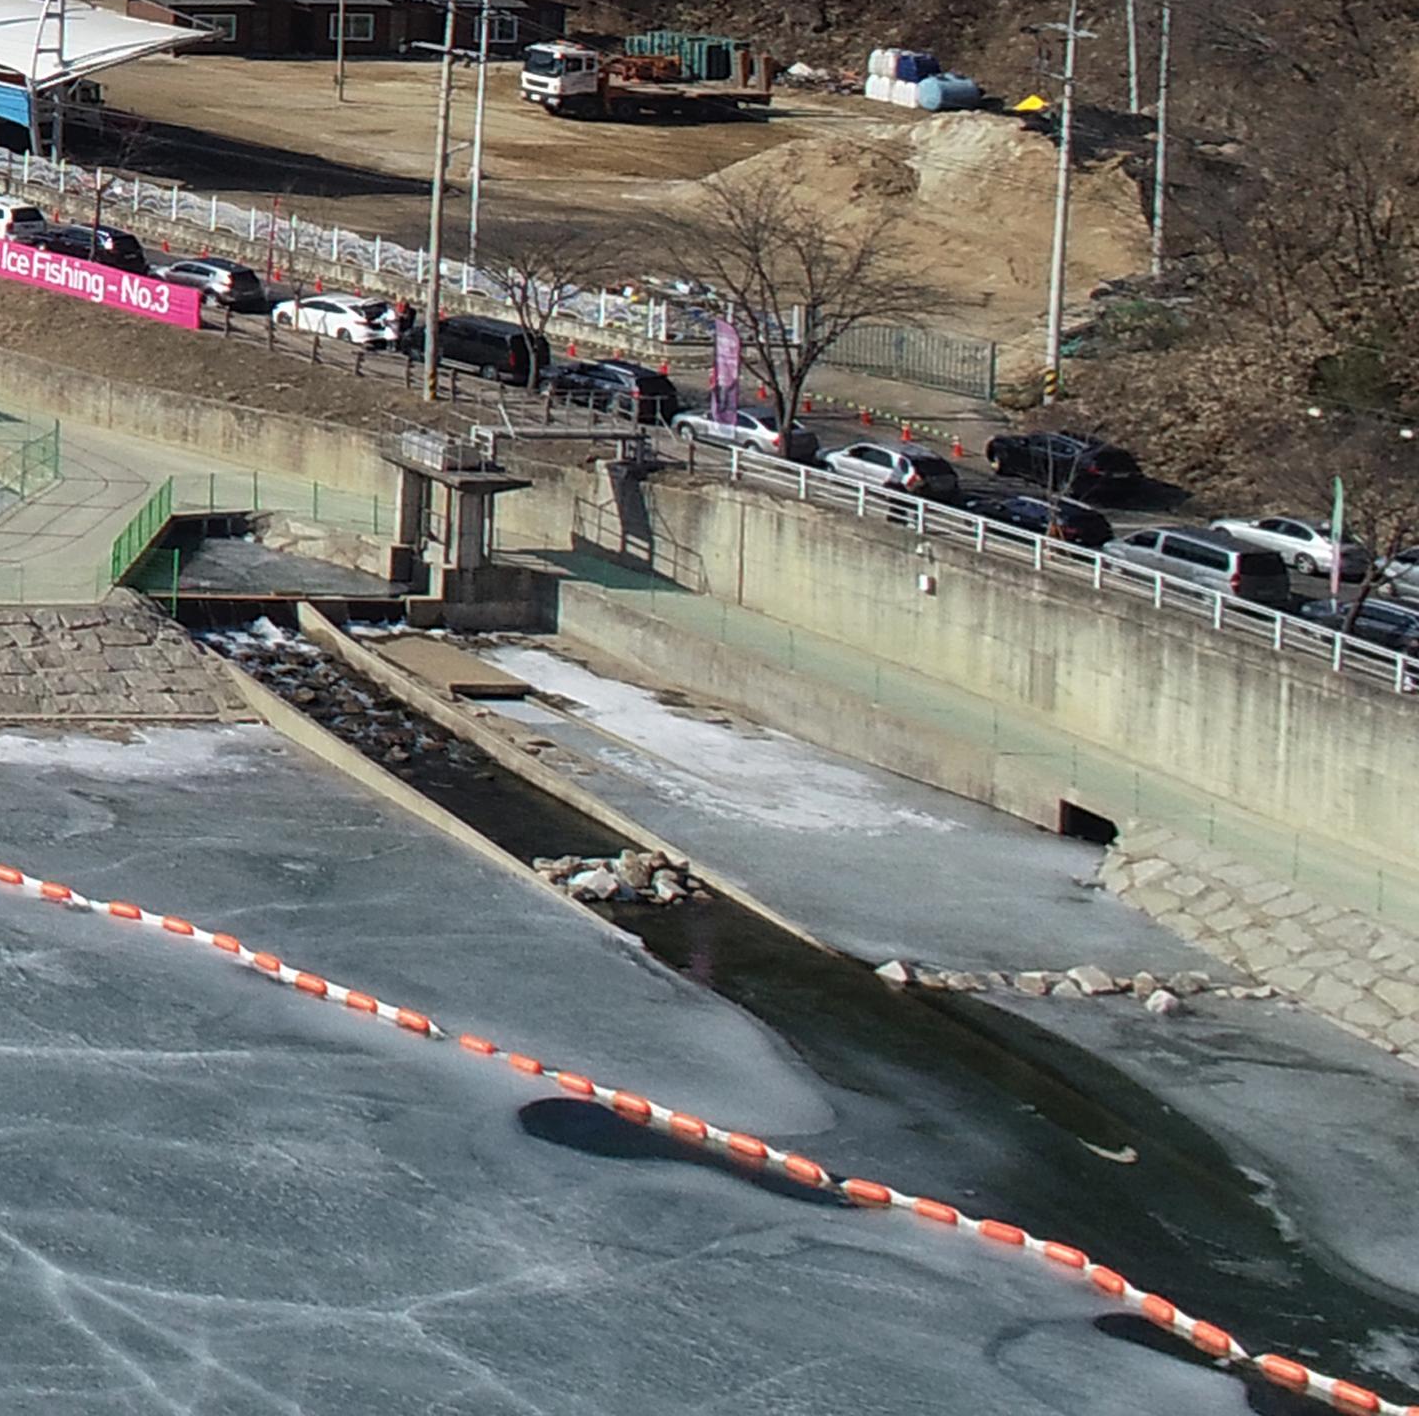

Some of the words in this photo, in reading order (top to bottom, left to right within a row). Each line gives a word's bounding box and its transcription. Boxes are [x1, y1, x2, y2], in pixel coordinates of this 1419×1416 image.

[1, 242, 30, 275] Ice
[32, 252, 104, 303] Fishing
[120, 275, 169, 313] No.3
